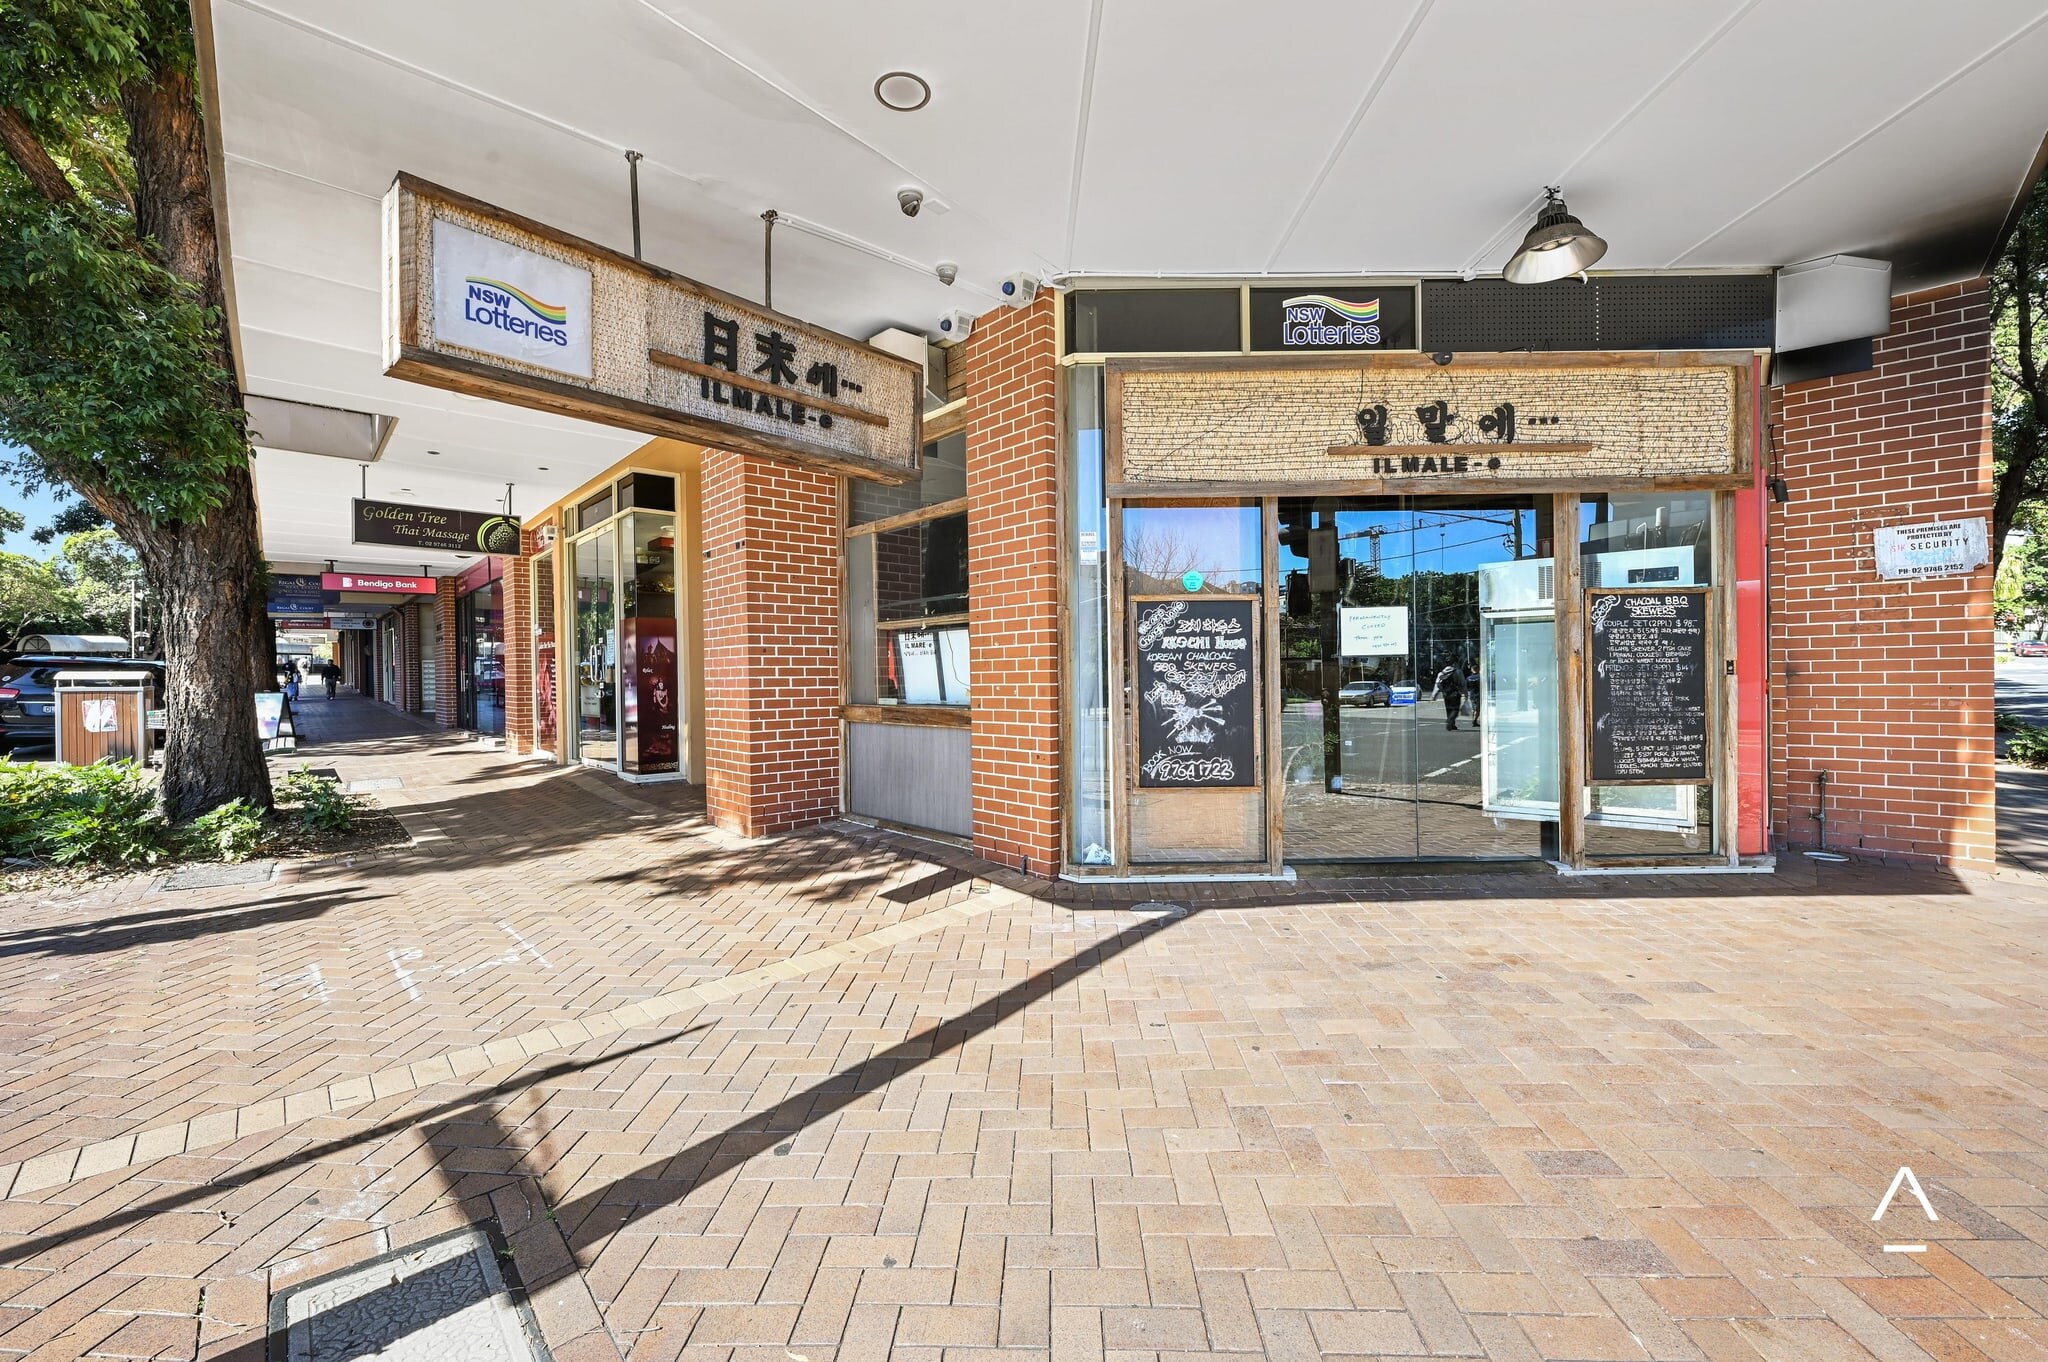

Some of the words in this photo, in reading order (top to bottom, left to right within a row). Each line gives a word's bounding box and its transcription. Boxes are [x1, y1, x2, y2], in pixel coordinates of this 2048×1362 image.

[469, 285, 510, 308] NSW
[1287, 308, 1326, 322] NSW
[466, 299, 568, 346] Lotteries
[1284, 322, 1380, 344] Lotteries
[363, 506, 414, 521] Golden
[418, 511, 447, 524] Tree
[393, 524, 419, 536] Thai
[422, 527, 470, 542] Massage
[1916, 526, 1948, 534] PREMISES
[1910, 538, 1969, 550] SECURITY
[358, 580, 393, 589] Bendigo
[396, 580, 417, 588] Bank
[1626, 597, 1661, 606] CHACOAL
[1631, 606, 1676, 616] SKEWERS
[1147, 653, 1182, 661] KOREAN
[1153, 662, 1177, 672] BBQ
[1183, 661, 1236, 671] SKEWERS
[1141, 750, 1166, 774] BOOK
[1168, 745, 1193, 754] NOW
